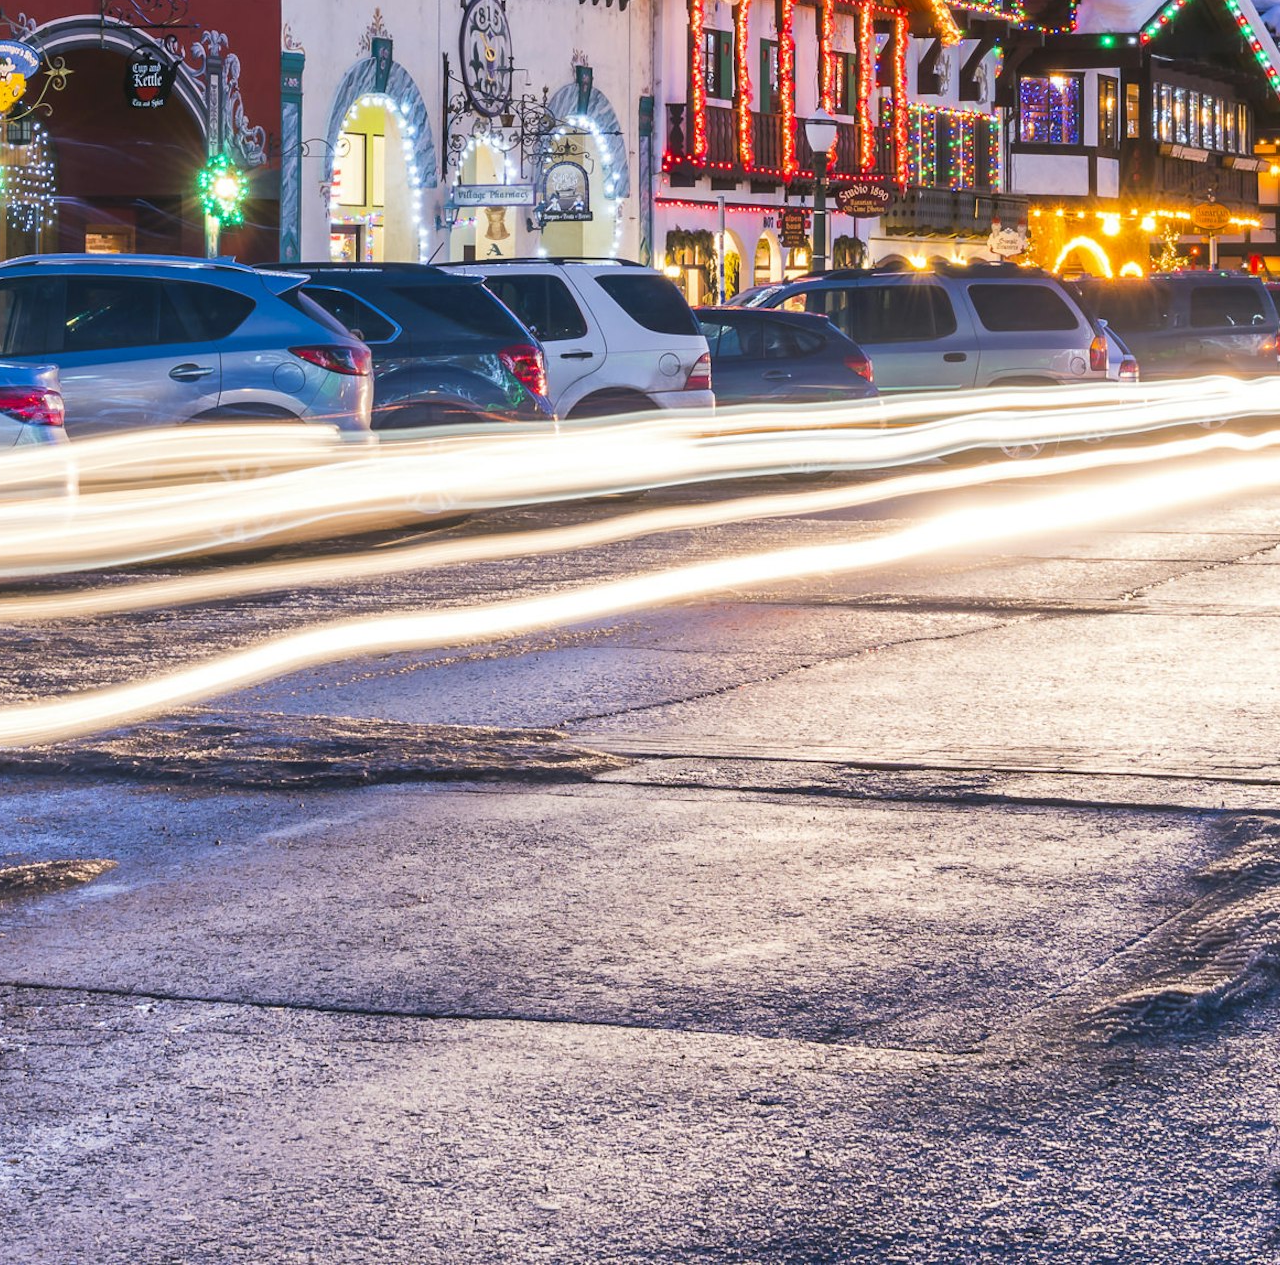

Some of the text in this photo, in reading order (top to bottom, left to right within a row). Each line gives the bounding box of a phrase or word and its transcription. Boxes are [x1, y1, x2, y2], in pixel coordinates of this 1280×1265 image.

[478, 5, 500, 26] 815
[23, 49, 39, 67] Shop
[132, 62, 162, 76] Cup and
[132, 73, 163, 87] Kettle
[458, 189, 529, 203] Village Pharmacy
[838, 183, 889, 203] Studio 1890
